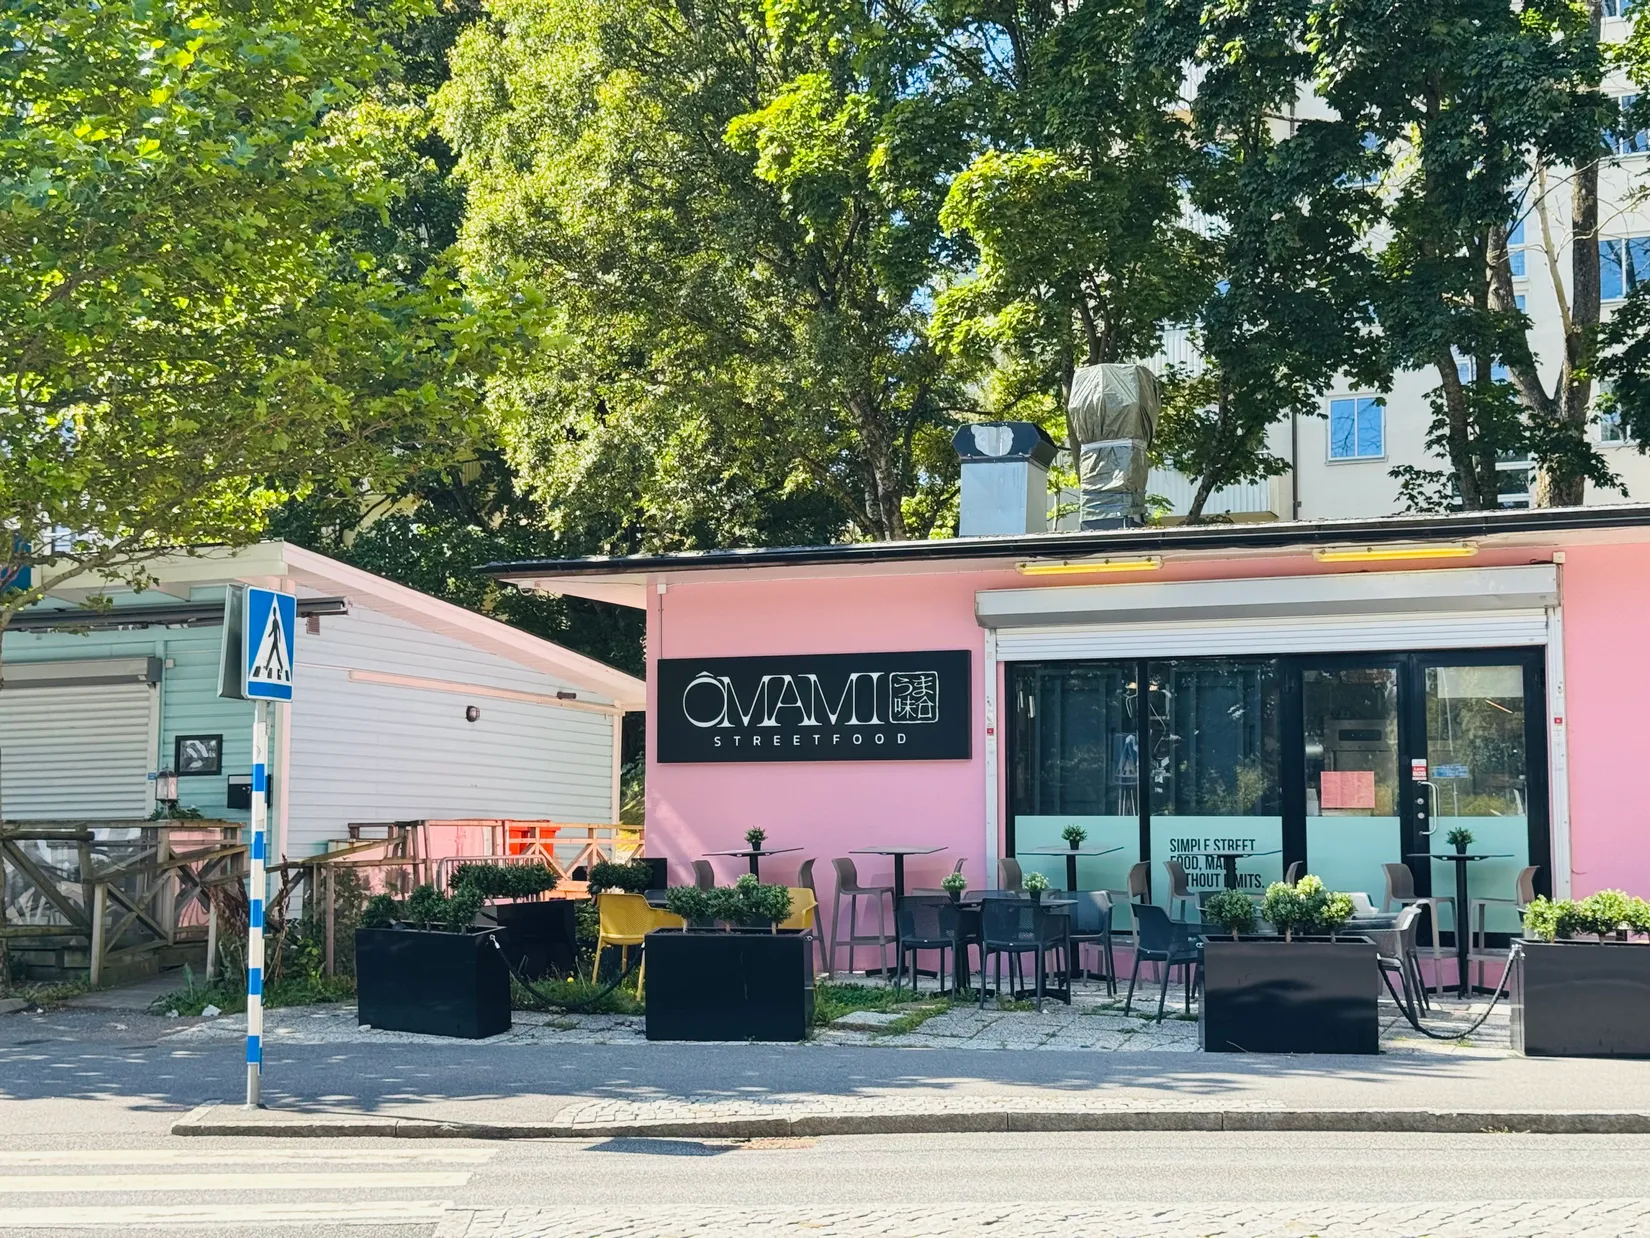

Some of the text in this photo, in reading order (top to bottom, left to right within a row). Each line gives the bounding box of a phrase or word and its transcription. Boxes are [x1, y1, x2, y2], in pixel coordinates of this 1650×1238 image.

[893, 675, 934, 697] うま
[714, 733, 907, 747] STREETFOOD
[1169, 838, 1257, 853] SIMPLE STREET
[1224, 873, 1265, 889] LMITS.
